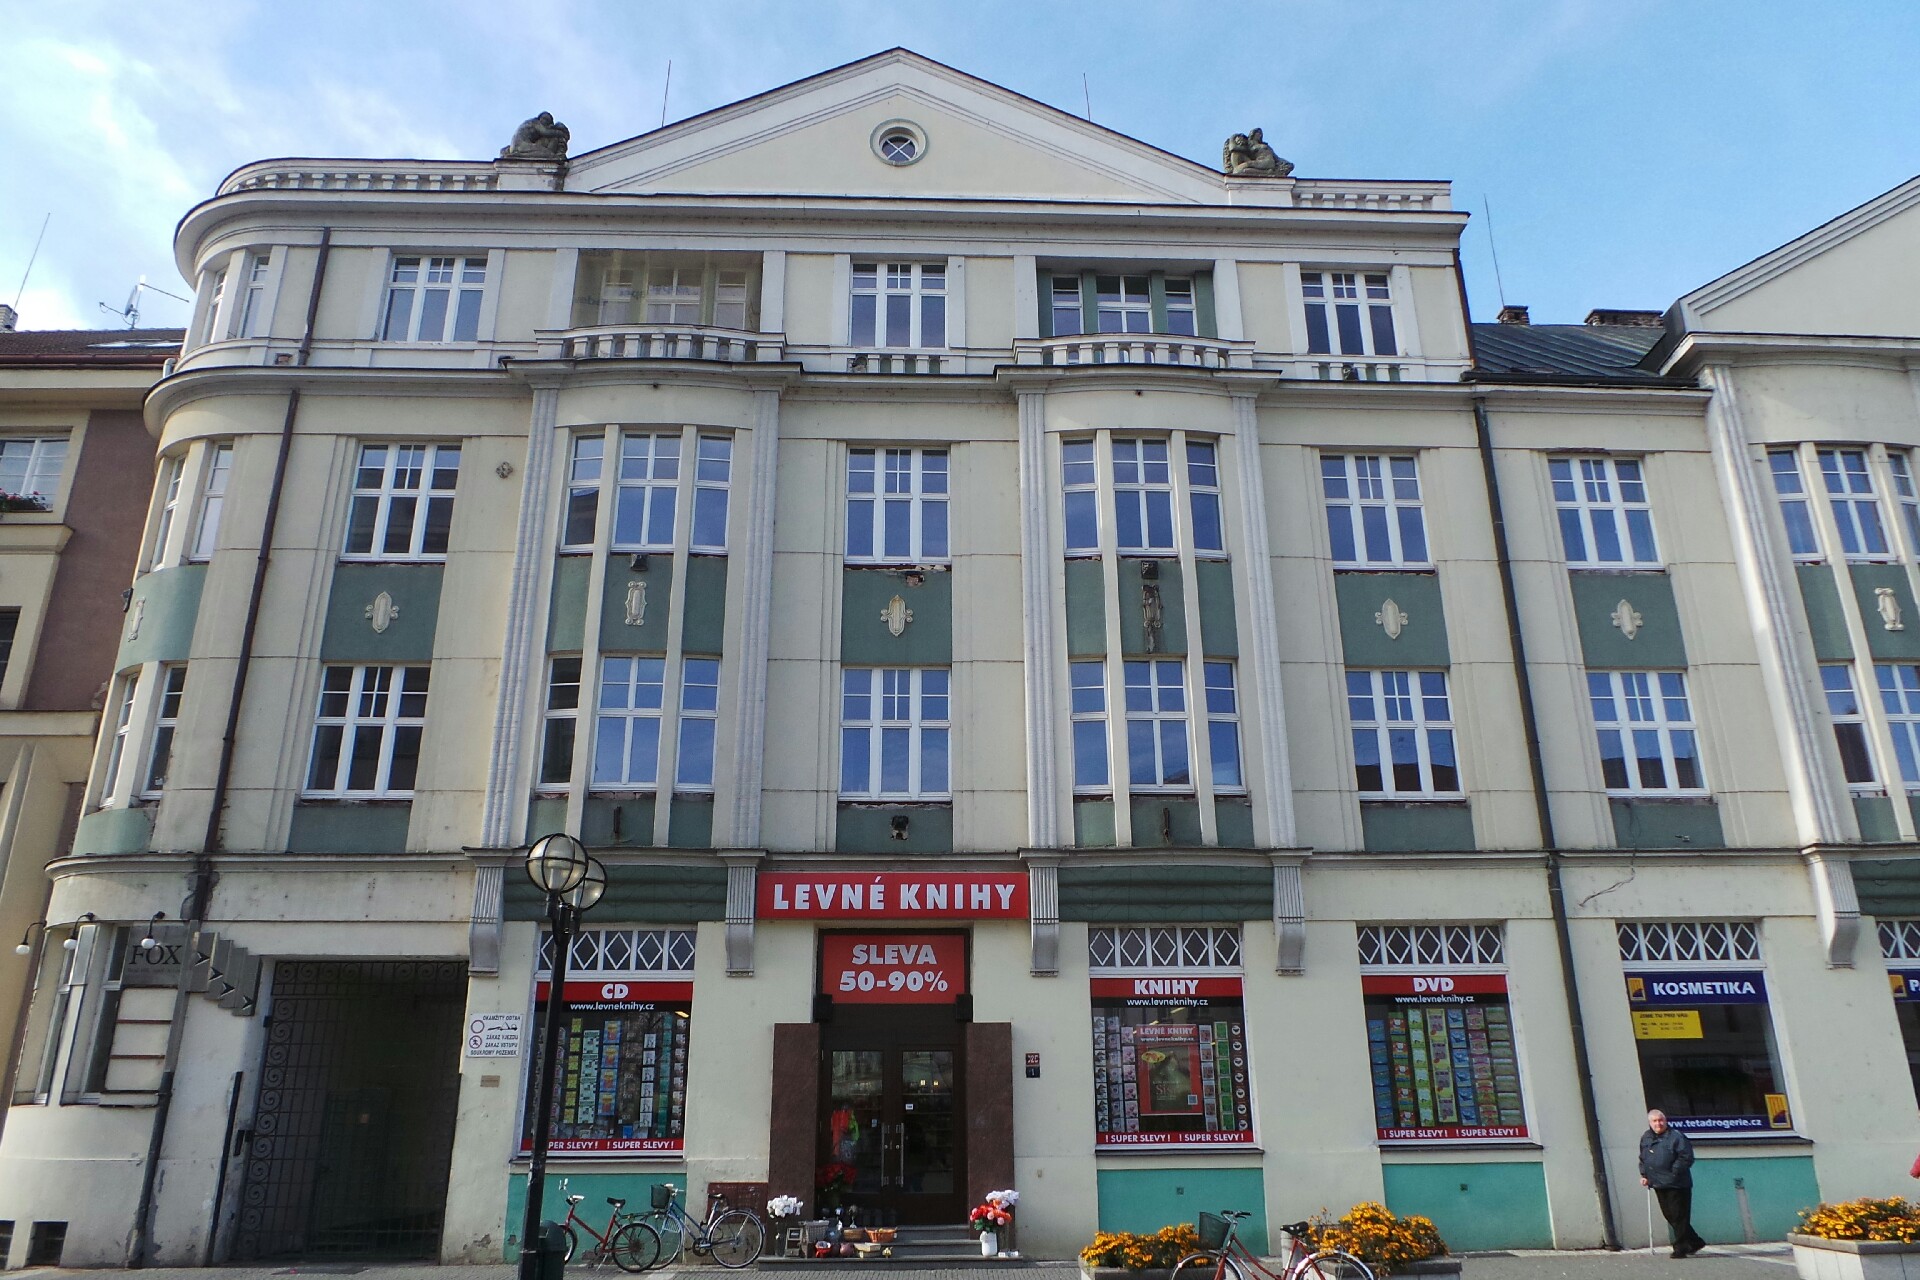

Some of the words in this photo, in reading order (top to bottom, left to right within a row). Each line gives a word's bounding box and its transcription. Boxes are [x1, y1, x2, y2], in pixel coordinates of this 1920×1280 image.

[773, 876, 885, 910] LEVNÉ
[900, 883, 1016, 910] KNIHY
[129, 945, 182, 965] FOX
[852, 944, 937, 965] SLEVA
[839, 970, 948, 992] 50-90%
[1413, 977, 1455, 992] DVD
[1908, 979, 1920, 992] P
[601, 983, 629, 999] CD
[1134, 979, 1200, 995] KNIHY
[1652, 981, 1756, 996] KOSMETIKA
[1126, 997, 1209, 1008] www.levneknihy.cz
[1395, 994, 1475, 1004] www.levneknihy.cz
[570, 1001, 655, 1012] www.levneknihy.cz
[1667, 1118, 1762, 1129] ww.tetadrogerie.cz
[1184, 1133, 1211, 1142] SUPER
[1389, 1129, 1416, 1138] SUPER
[1461, 1128, 1487, 1137] SUPER
[1110, 1134, 1138, 1143] SUPER
[548, 1141, 564, 1149] PER
[612, 1141, 640, 1149] SUPER
